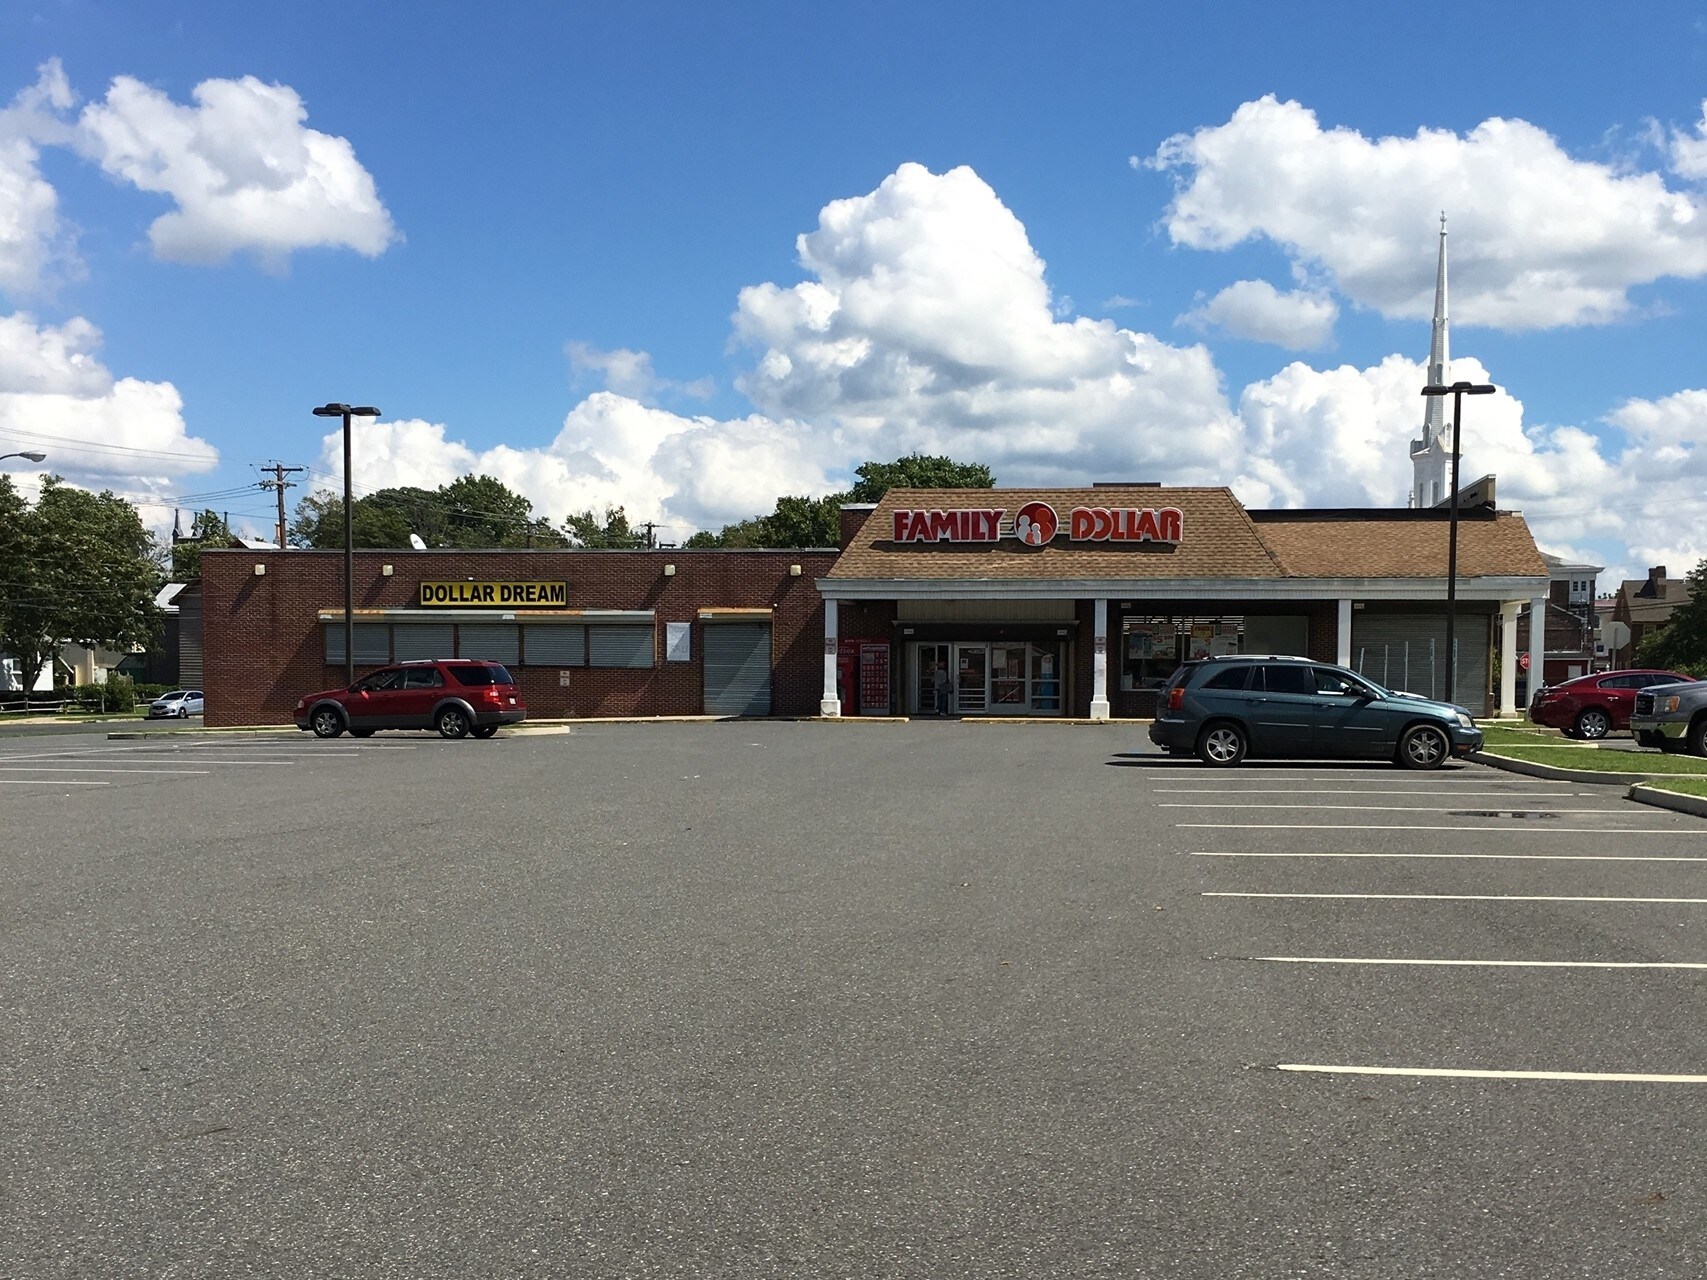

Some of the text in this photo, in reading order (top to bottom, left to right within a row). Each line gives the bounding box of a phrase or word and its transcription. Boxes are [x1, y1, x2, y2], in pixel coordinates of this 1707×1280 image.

[893, 507, 1183, 543] FAMILY DOLLAR
[422, 585, 564, 602] DOLLAR DREAM
